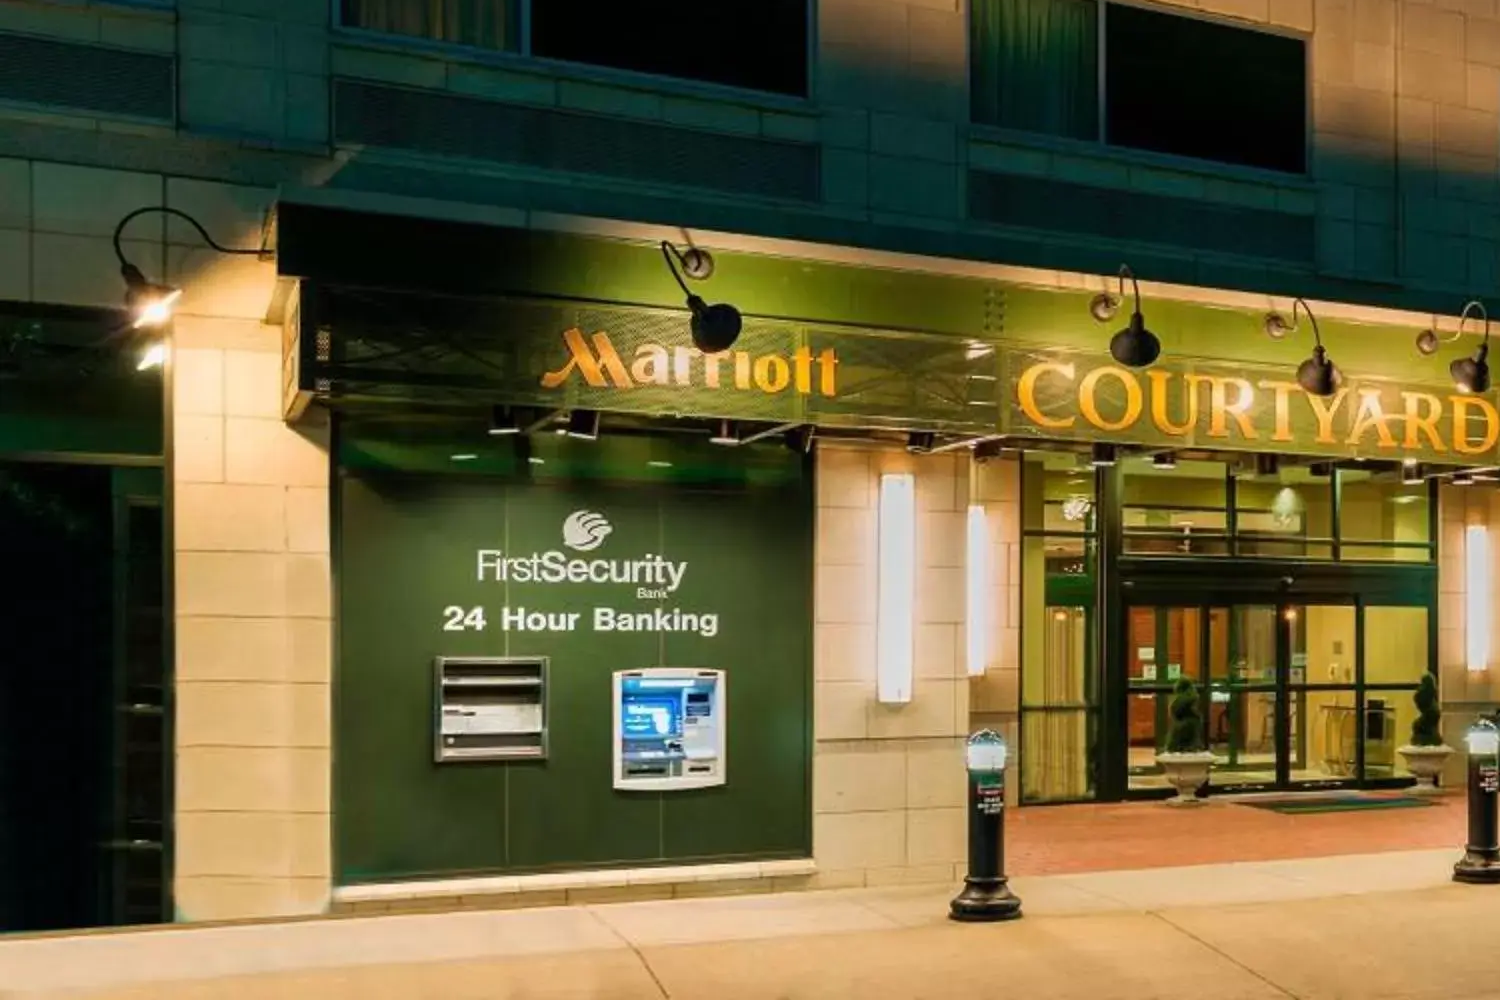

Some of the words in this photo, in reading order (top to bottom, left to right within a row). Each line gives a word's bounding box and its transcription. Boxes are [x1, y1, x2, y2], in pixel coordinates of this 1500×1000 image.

[540, 327, 839, 398] Marriott
[1016, 362, 1500, 455] COURTYARD
[476, 549, 688, 592] FirstSecurity
[636, 587, 668, 600] Bank
[443, 605, 487, 632] 24
[501, 606, 580, 632] Hour
[593, 607, 719, 637] Banking
